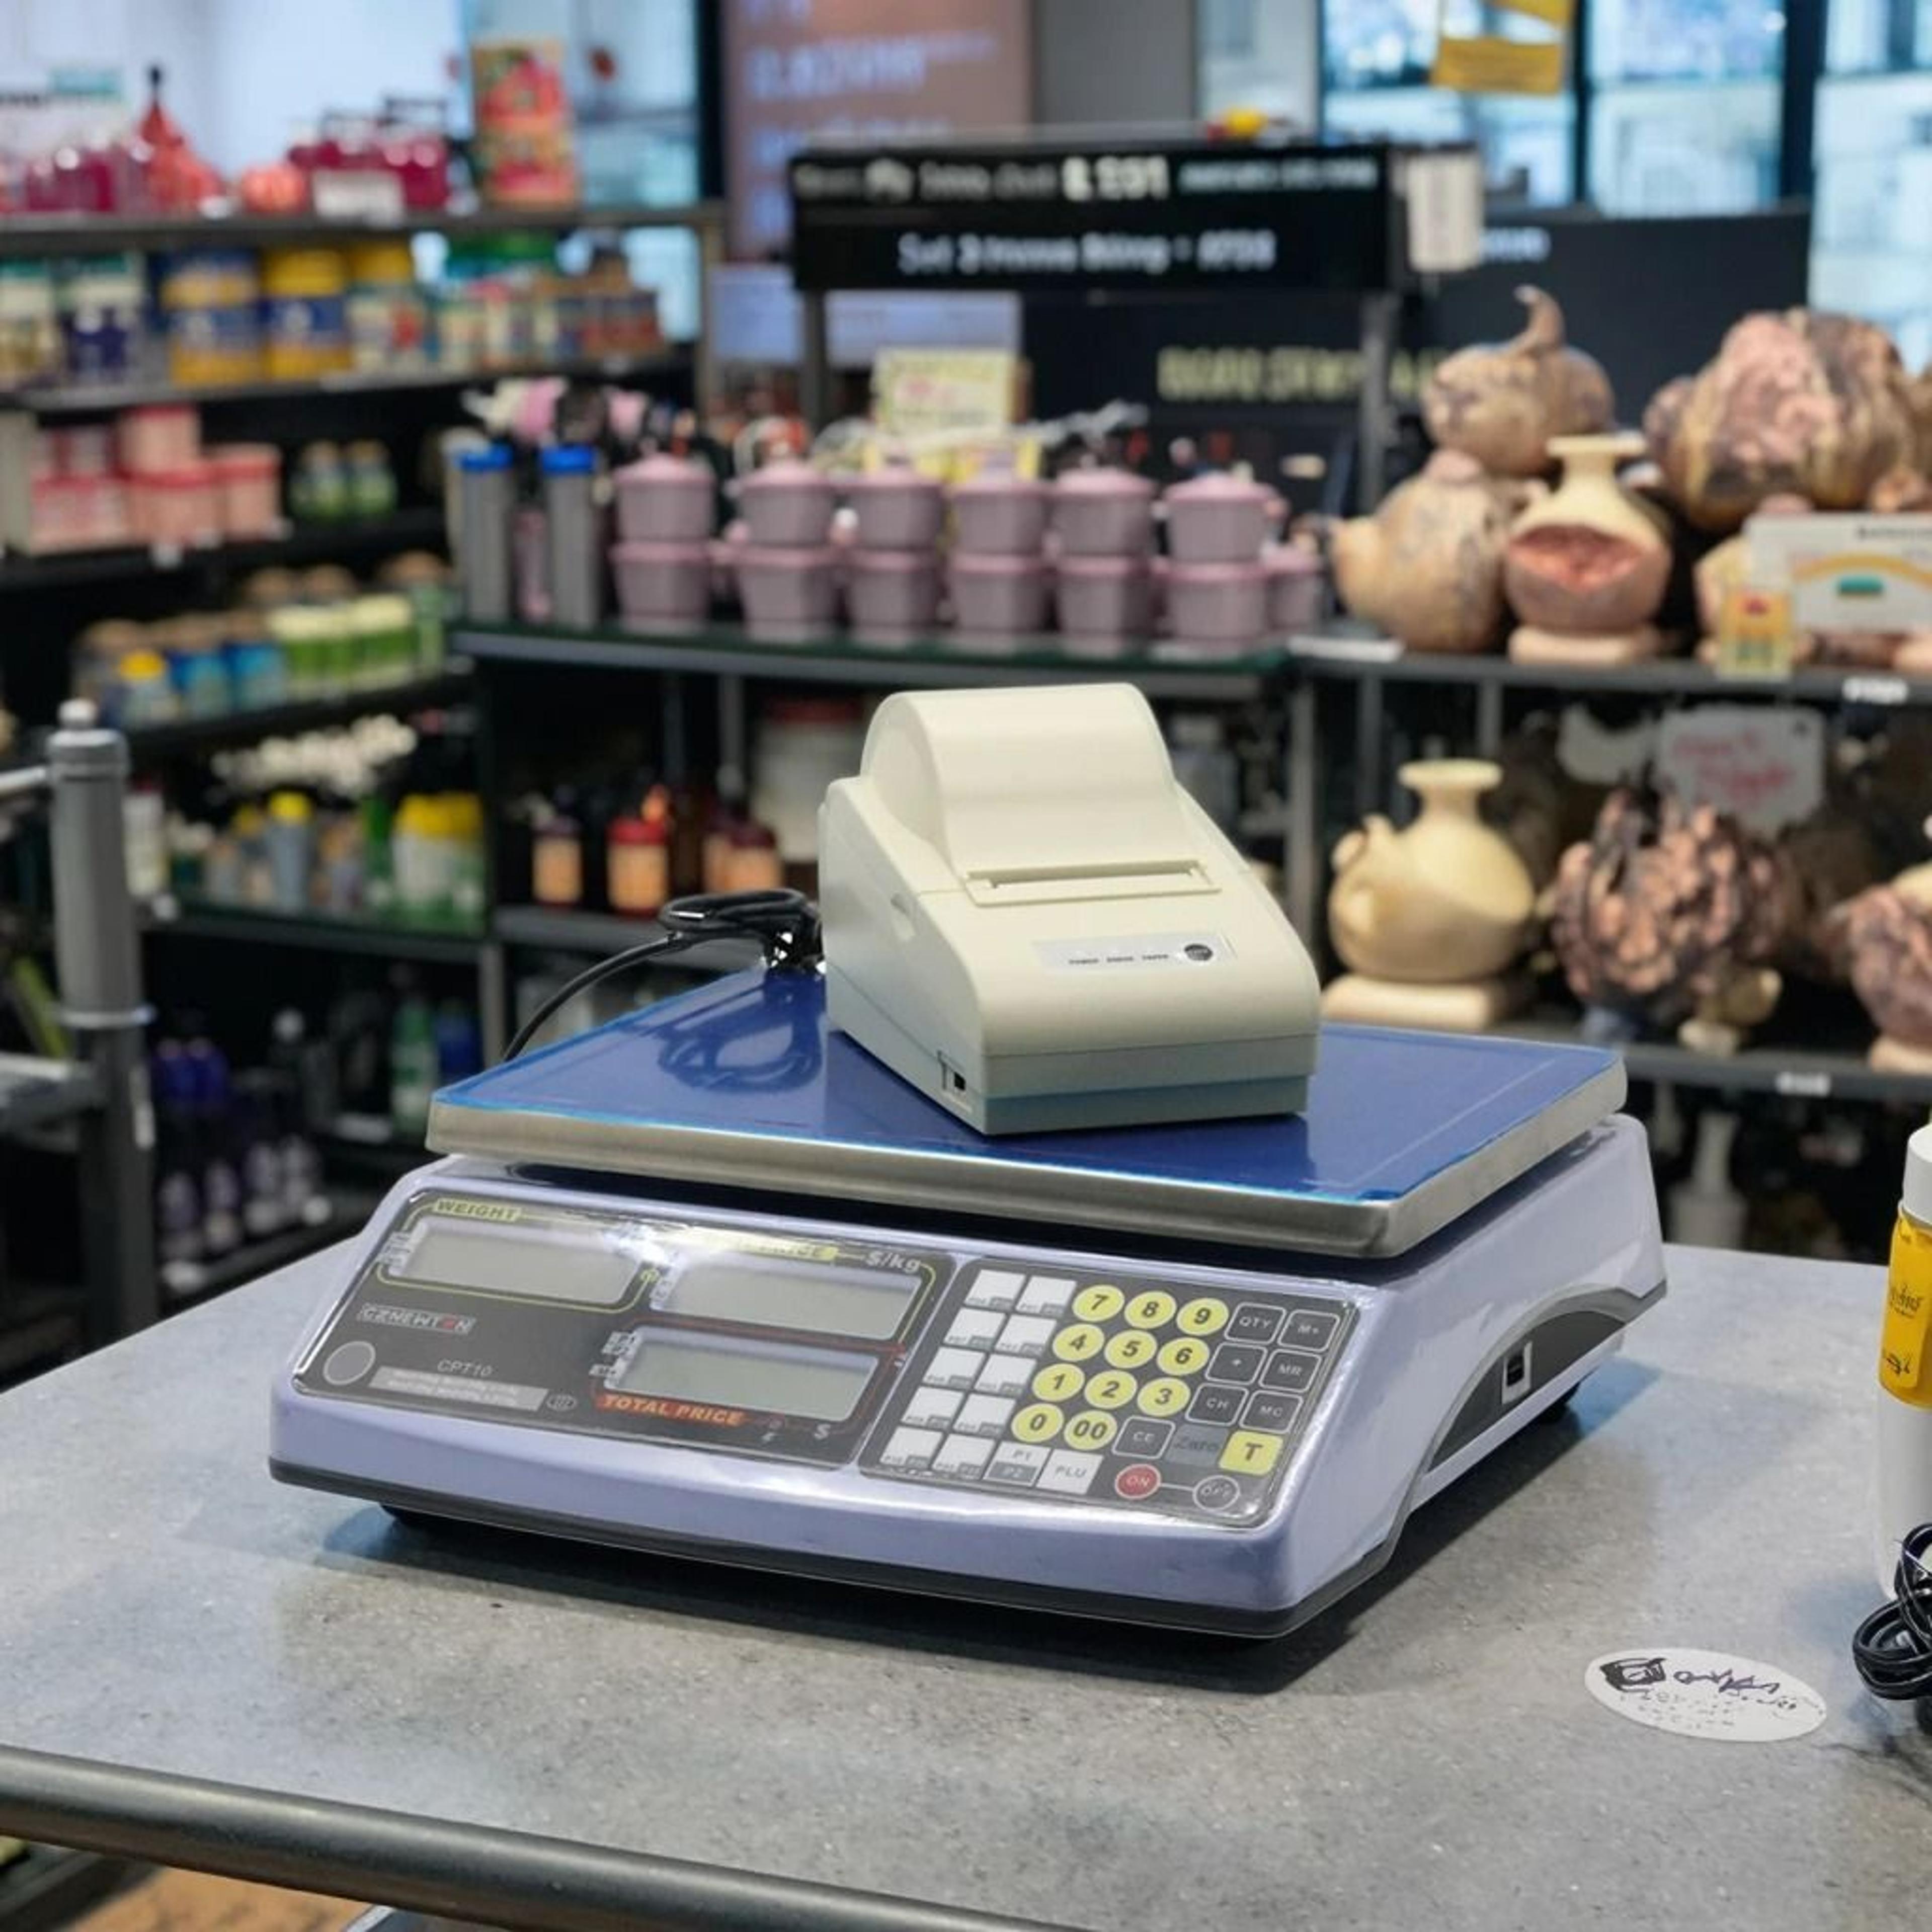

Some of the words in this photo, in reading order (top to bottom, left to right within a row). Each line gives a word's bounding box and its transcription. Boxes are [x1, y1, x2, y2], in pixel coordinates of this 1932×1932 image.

[437, 1201, 517, 1220] WEIGHT
[1091, 1295, 1108, 1310] 7
[1142, 1301, 1159, 1318] 8
[1193, 1308, 1211, 1325] 9
[1239, 1316, 1271, 1328] QTY
[1069, 1335, 1087, 1351] 4
[1122, 1340, 1141, 1357] 5
[1175, 1347, 1193, 1364] 6
[1053, 1374, 1066, 1390] 1
[1101, 1381, 1119, 1398] 2
[1154, 1388, 1172, 1405] 3
[604, 1394, 671, 1415] TOTAL
[674, 1407, 745, 1426] PRICE
[1029, 1414, 1046, 1431] 0
[1073, 1420, 1107, 1440] 00
[1246, 1442, 1263, 1461] T
[1055, 1465, 1087, 1478] PLU
[1126, 1475, 1150, 1487] ON
